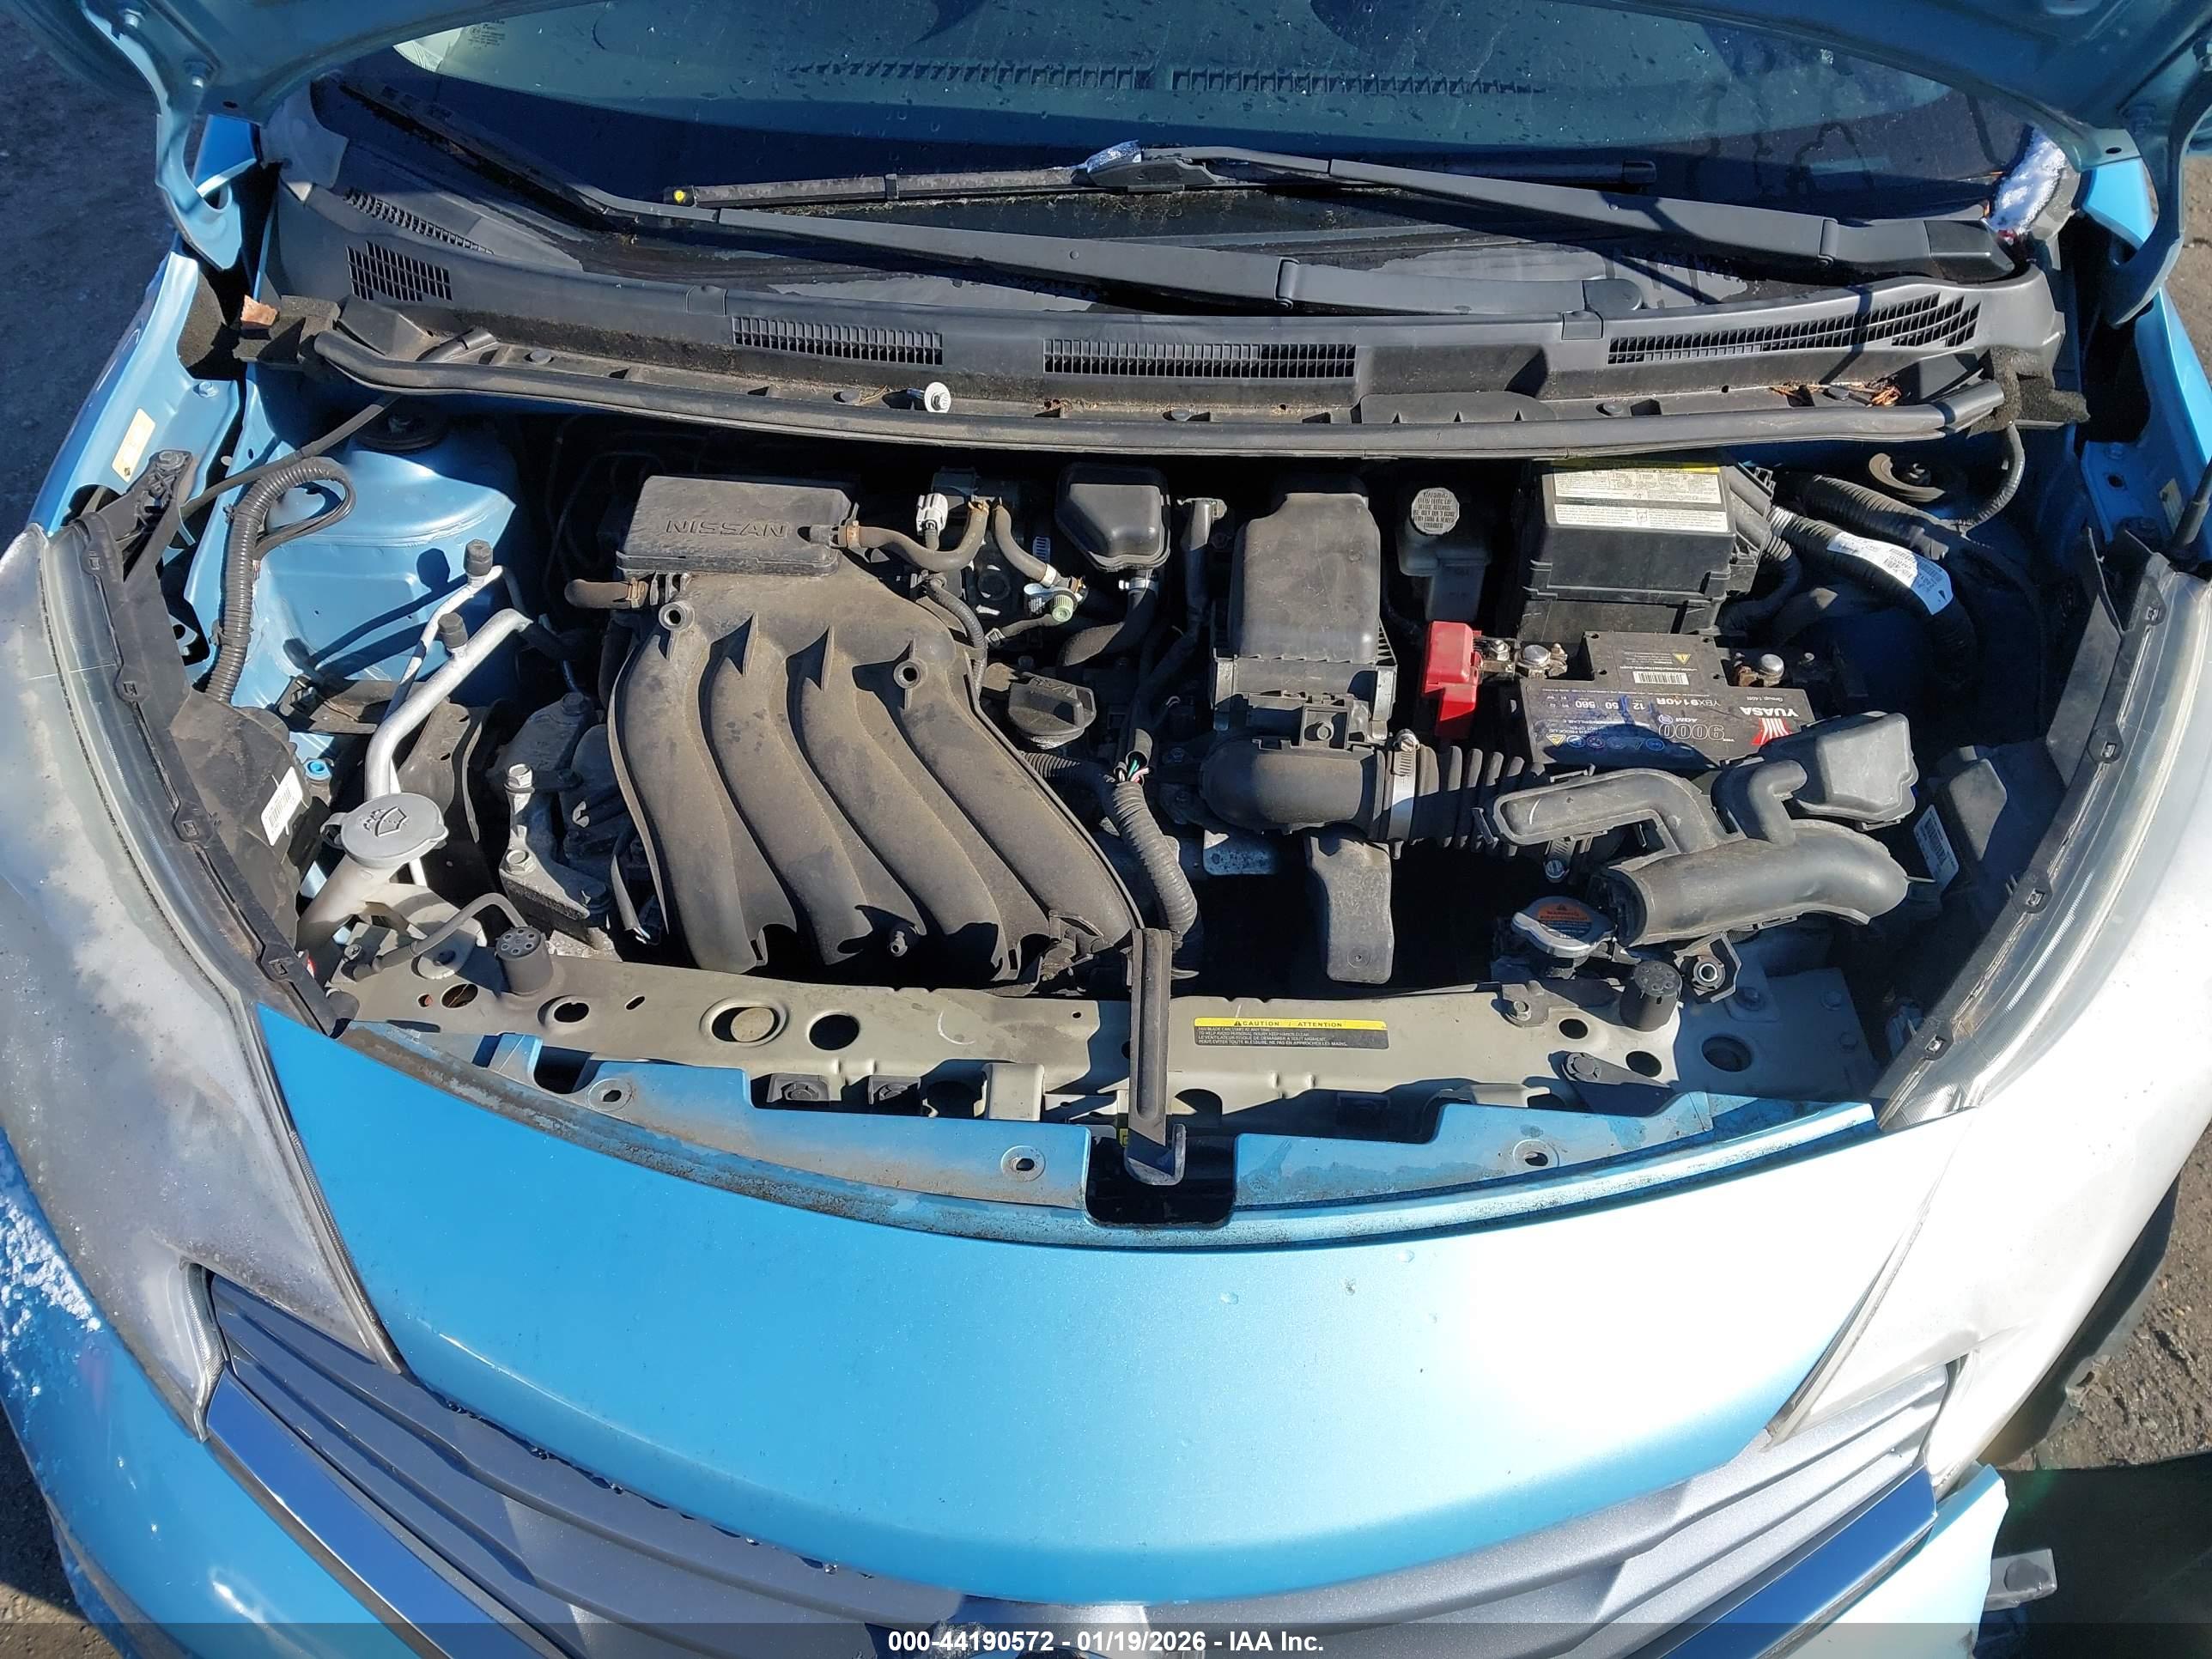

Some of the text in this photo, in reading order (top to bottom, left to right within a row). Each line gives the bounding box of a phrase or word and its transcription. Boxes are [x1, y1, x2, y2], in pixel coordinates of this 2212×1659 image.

[665, 520, 788, 538] NISSAN
[1605, 701, 1620, 709] 50
[1632, 702, 1646, 711] 12
[1739, 706, 1800, 717] YUASA
[1658, 724, 1725, 740] 9000
